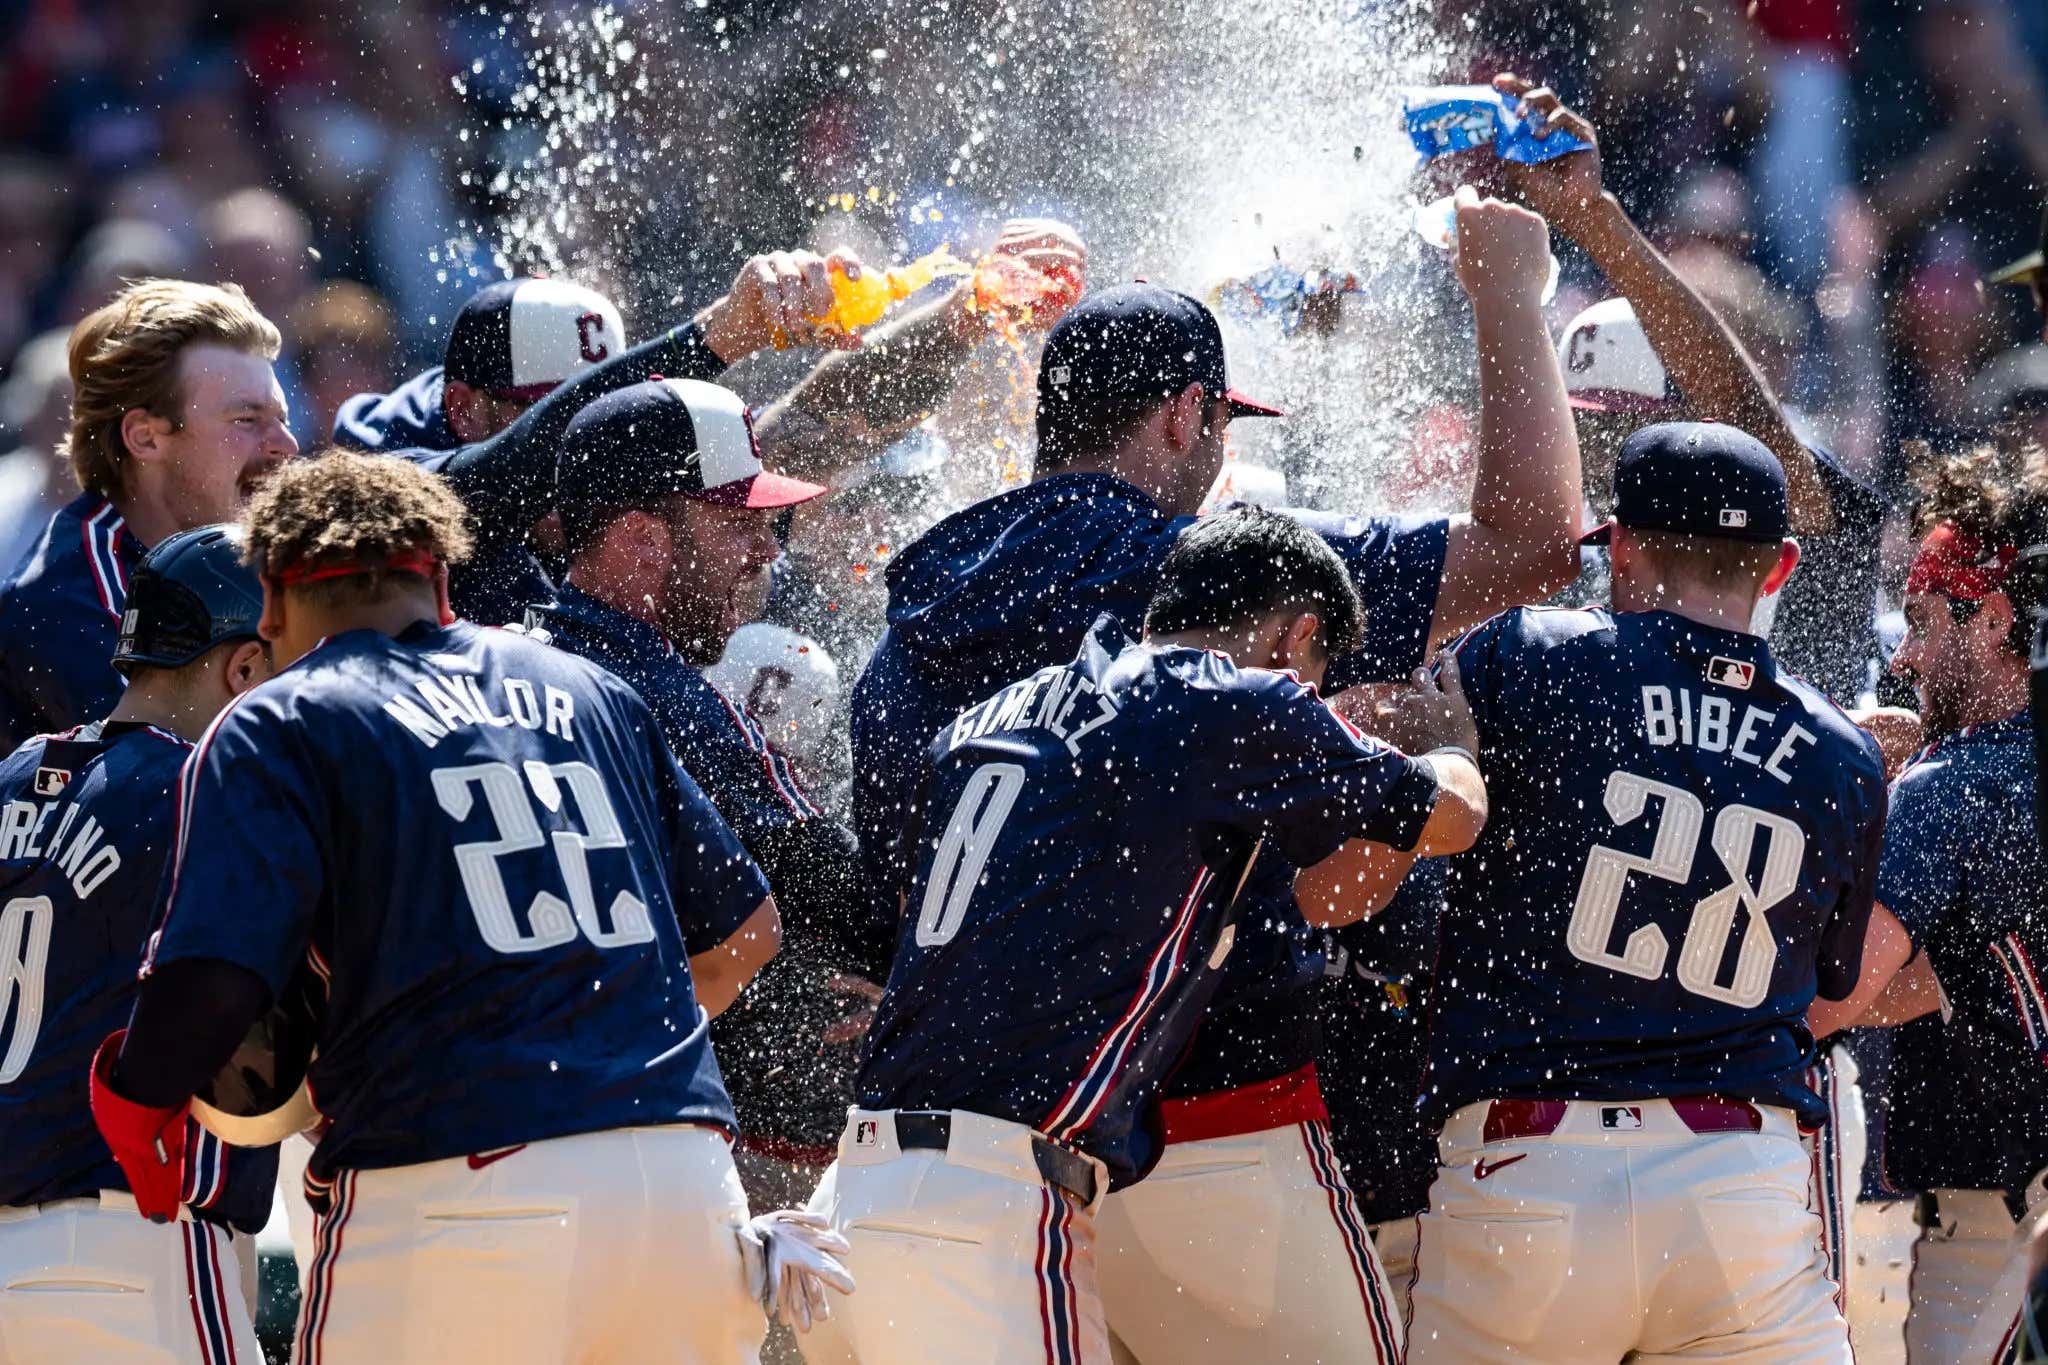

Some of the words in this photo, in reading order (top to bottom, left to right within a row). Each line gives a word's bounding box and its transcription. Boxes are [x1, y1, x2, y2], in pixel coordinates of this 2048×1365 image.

[575, 311, 608, 363] C
[1568, 324, 1599, 374] C
[383, 674, 575, 749] NAYLOR
[949, 669, 1119, 758] GIMENEZ
[1641, 685, 1818, 785] BIBEE
[430, 760, 656, 954] 22
[1566, 770, 1805, 1009] 28
